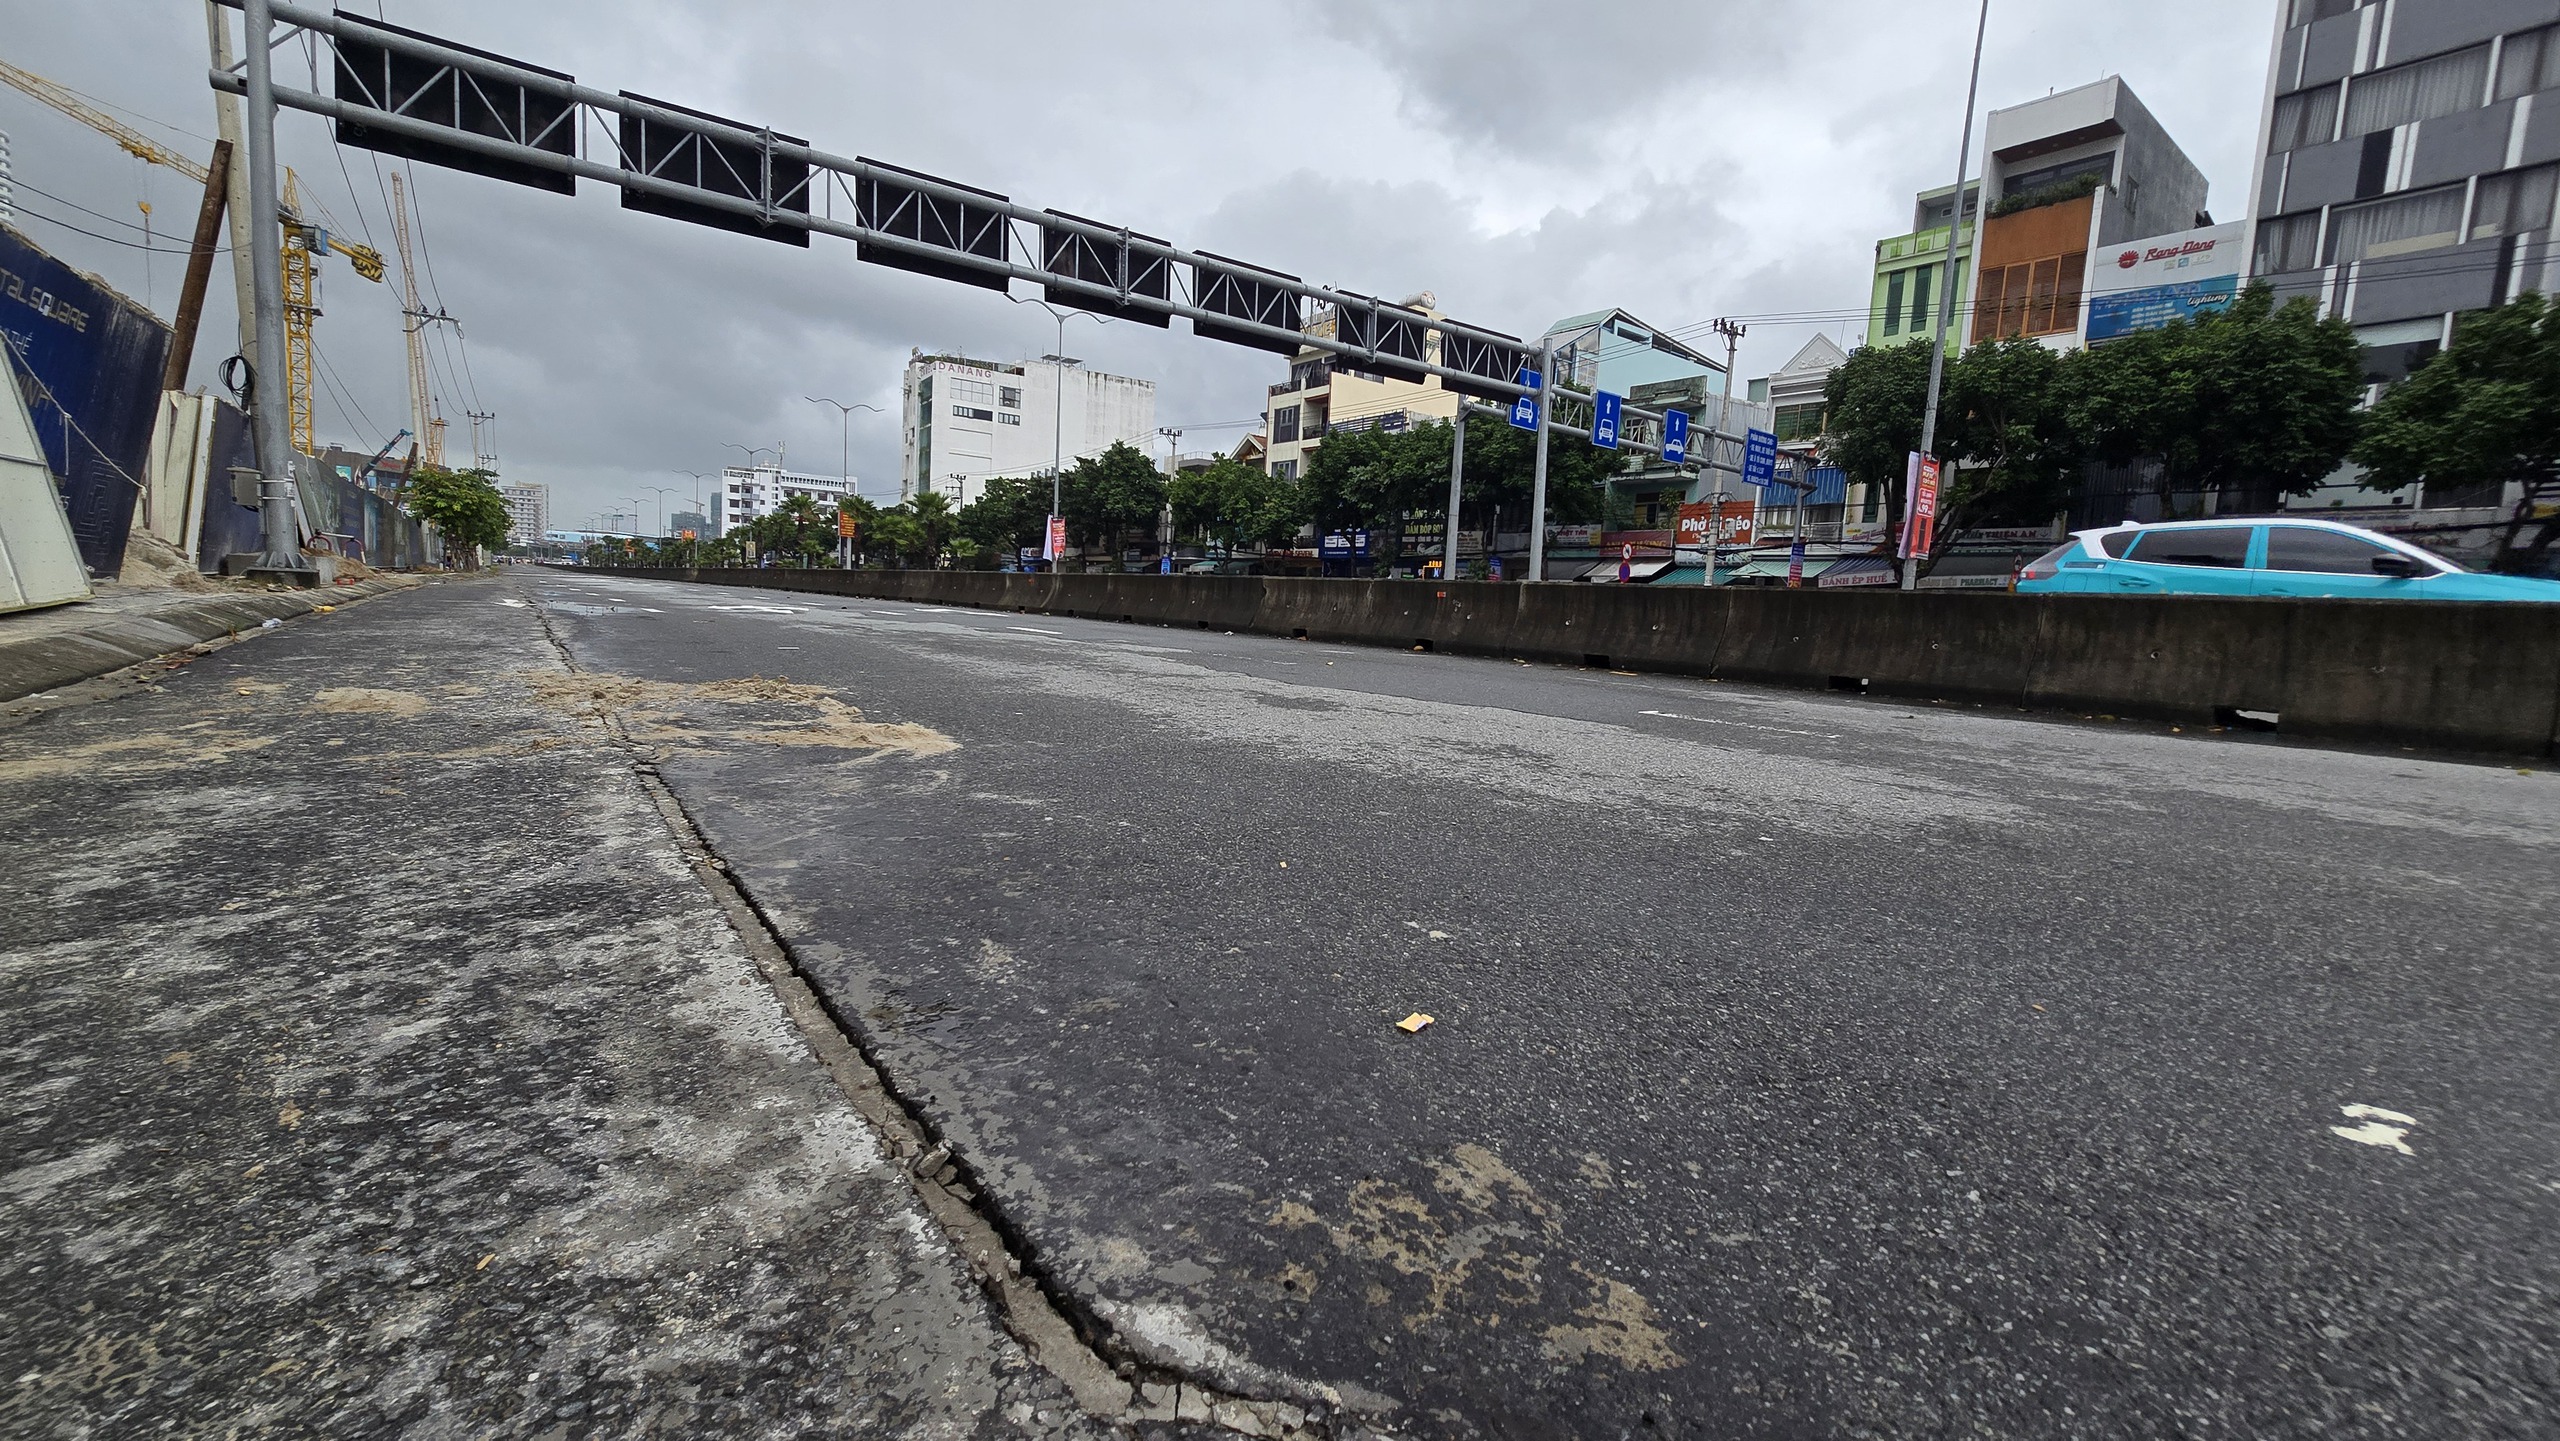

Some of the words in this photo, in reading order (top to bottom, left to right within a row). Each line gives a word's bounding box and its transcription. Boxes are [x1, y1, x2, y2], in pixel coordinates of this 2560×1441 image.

[938, 361, 992, 379] DANANG
[1681, 515, 1707, 532] Phở
[1822, 576, 1849, 586] BÁNH
[1960, 577, 1999, 586] PHARMACY
